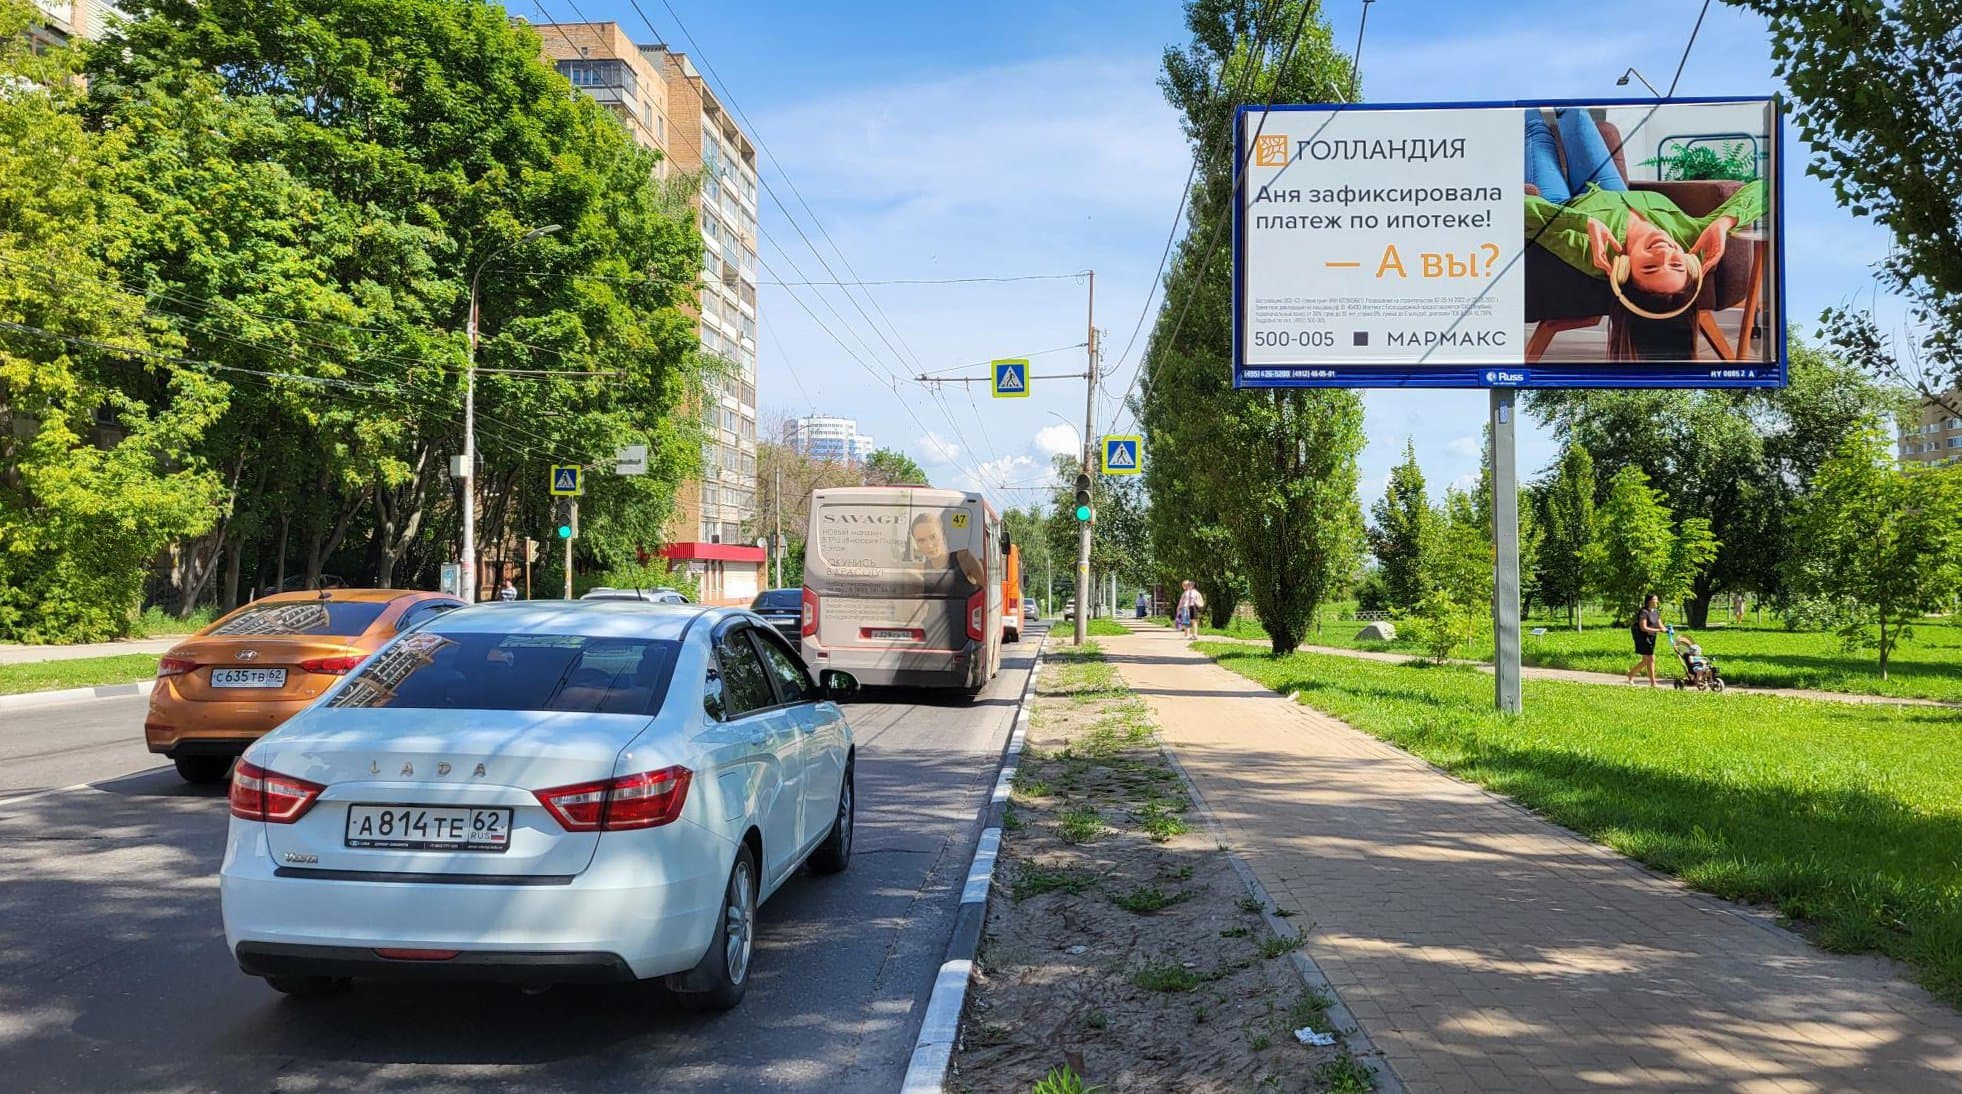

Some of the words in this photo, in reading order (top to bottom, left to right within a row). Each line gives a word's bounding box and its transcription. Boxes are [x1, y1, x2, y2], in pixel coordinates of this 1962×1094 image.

[1297, 138, 1466, 163] ГОЛЛАНДИЯ
[1256, 186, 1301, 203] Аня
[1309, 185, 1502, 206] зафиксировала
[1256, 214, 1342, 229] платеж
[1350, 214, 1378, 229] по
[1387, 210, 1492, 229] ипотеке!
[1376, 244, 1407, 278] А
[1420, 243, 1500, 278] вы?
[1255, 331, 1334, 347] 500-005
[1387, 331, 1506, 346] МАРМАКС
[1498, 372, 1524, 381] Russ
[824, 514, 907, 524] SAVAGE
[953, 515, 966, 523] 47
[217, 671, 265, 682] С635ТВ
[269, 670, 281, 679] 62
[370, 760, 486, 778] LADA
[359, 811, 464, 838] А814ТЕ
[473, 812, 499, 831] 62
